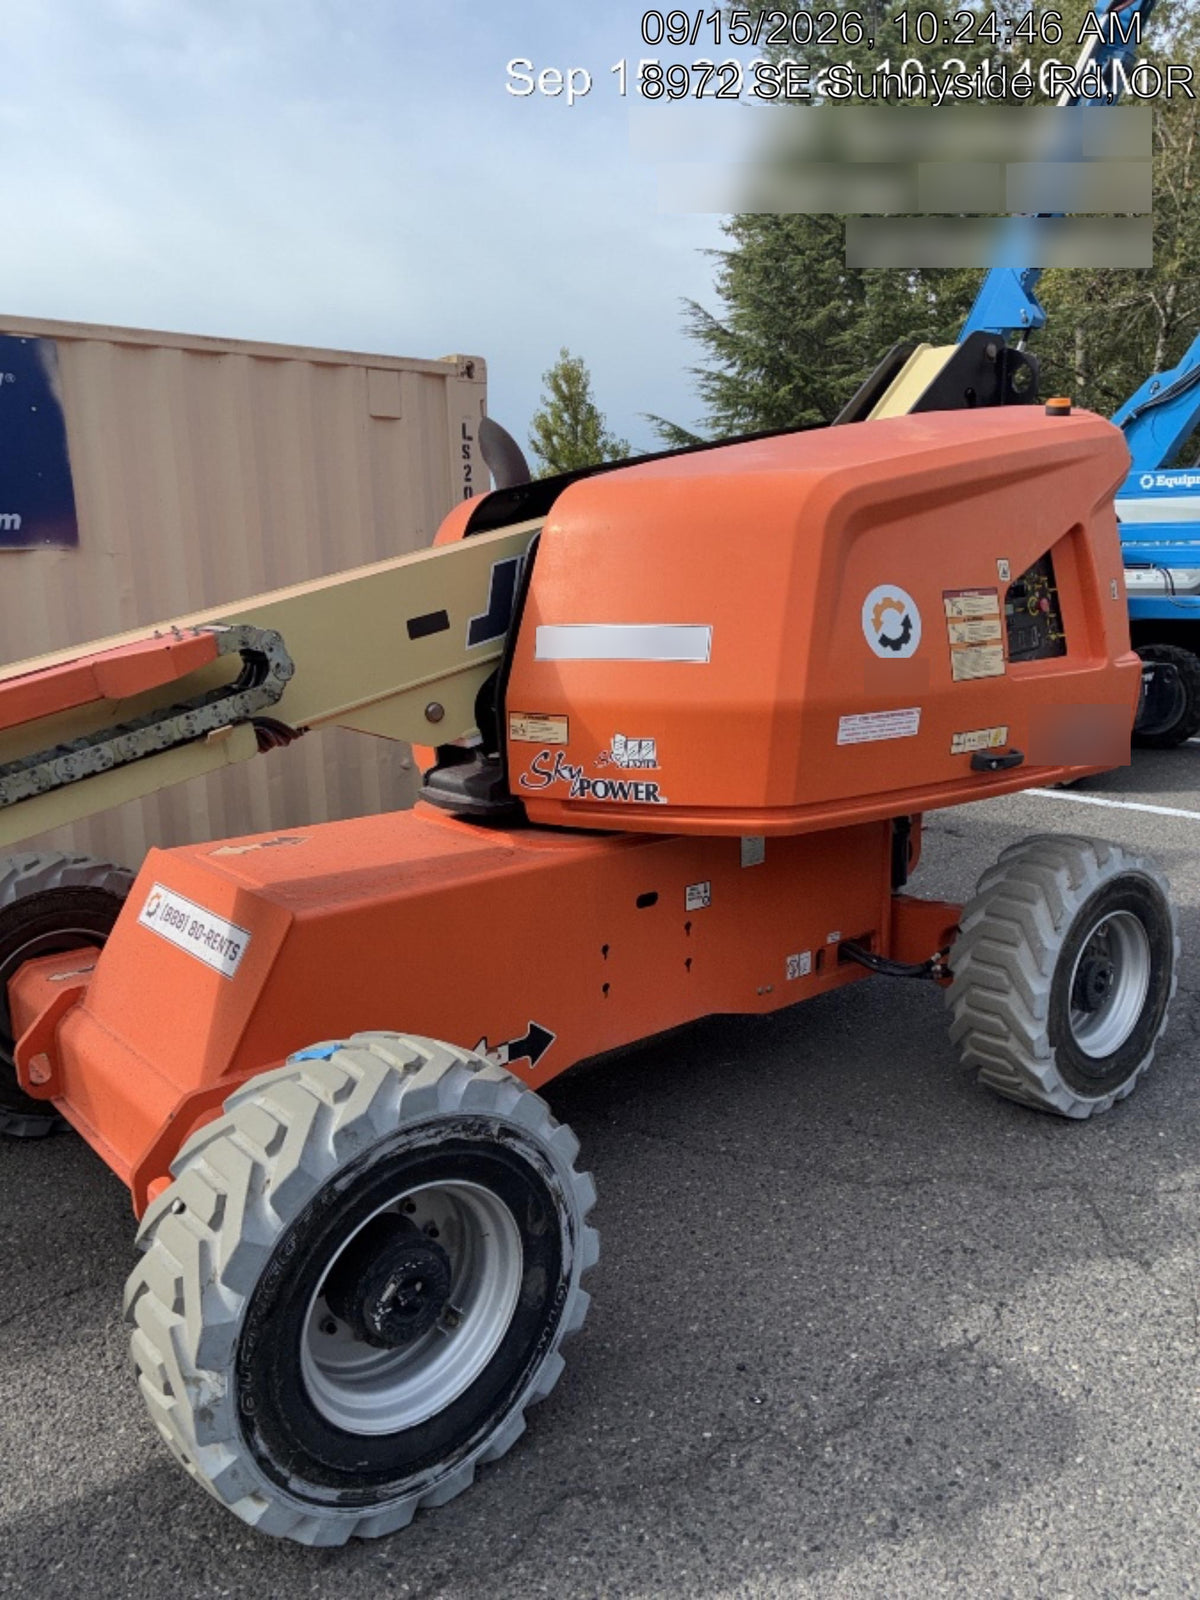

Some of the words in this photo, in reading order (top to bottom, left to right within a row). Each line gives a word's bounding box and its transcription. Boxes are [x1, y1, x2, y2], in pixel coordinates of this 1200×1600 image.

[519, 750, 584, 798] Sky
[578, 778, 661, 803] POWER
[160, 902, 190, 932] (888)
